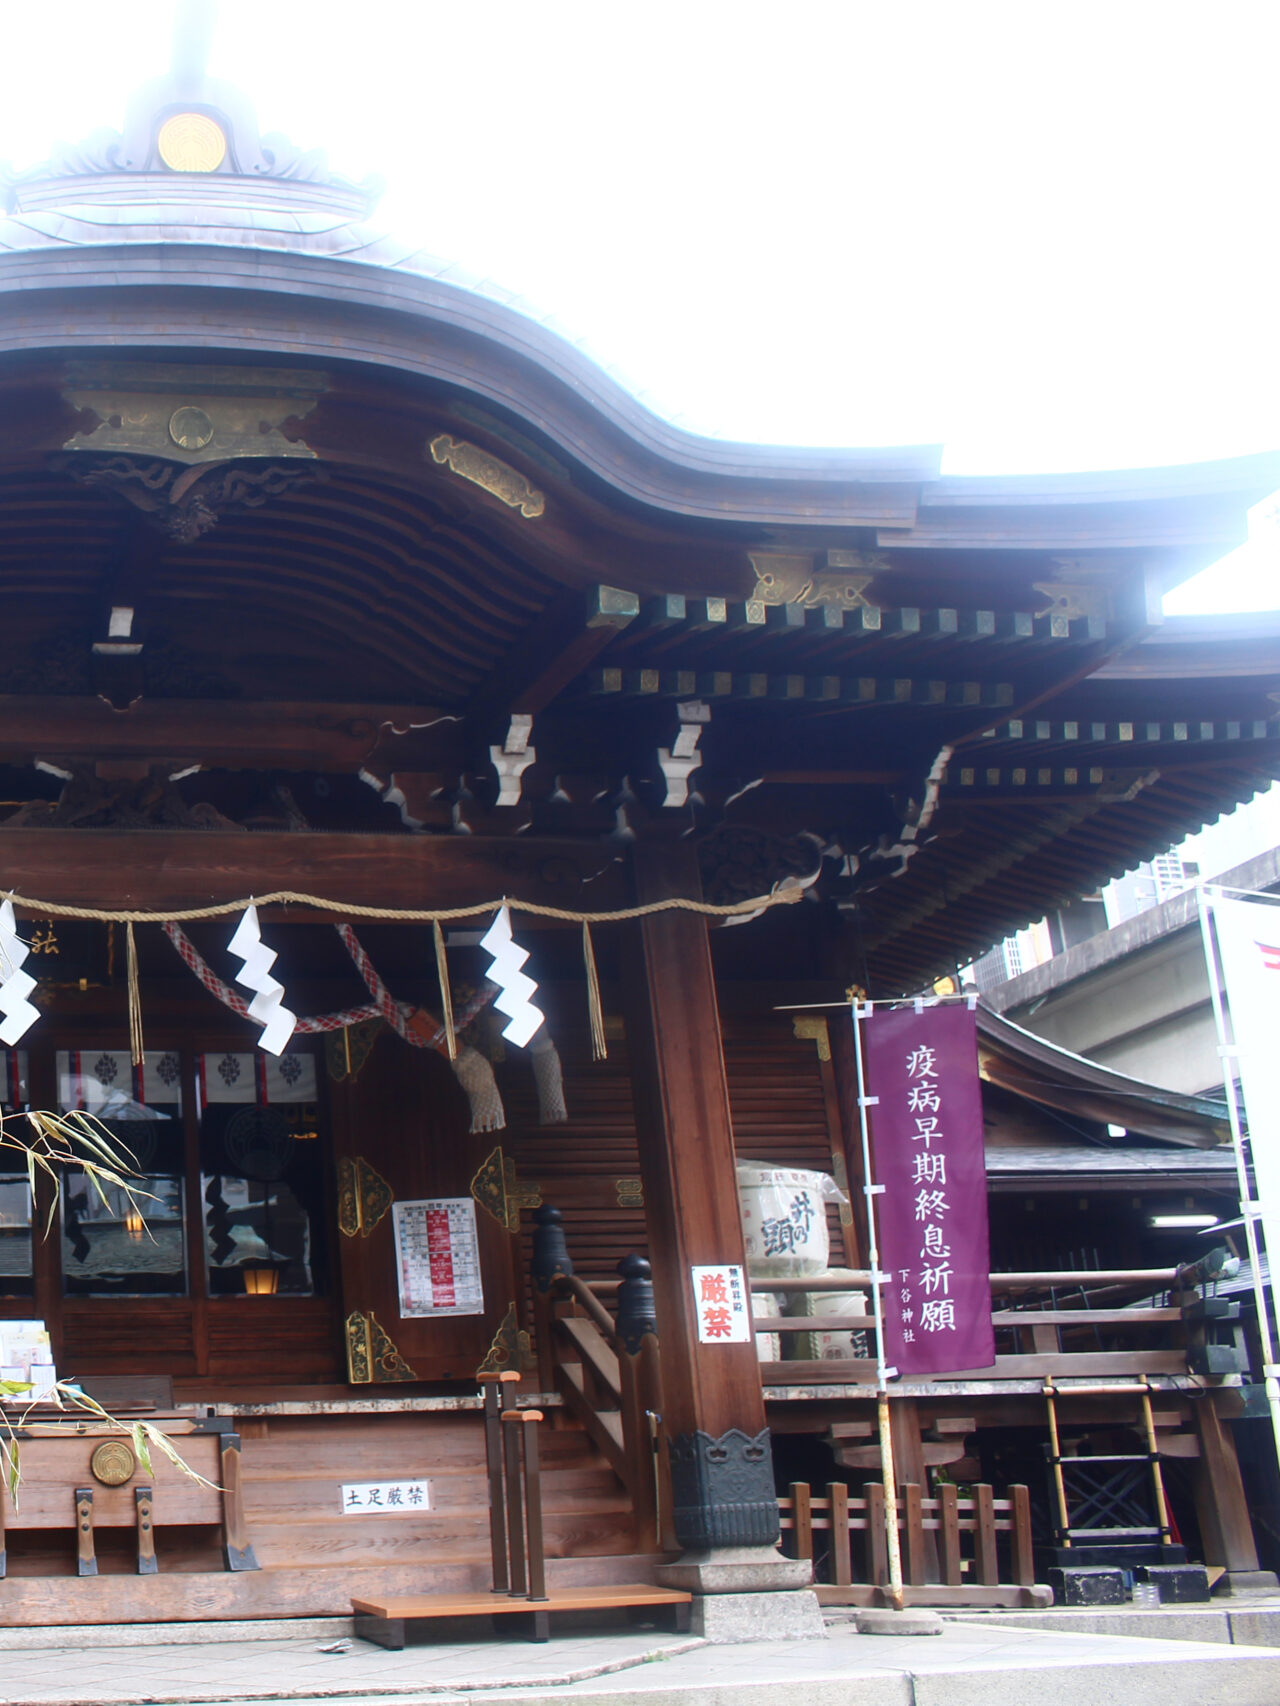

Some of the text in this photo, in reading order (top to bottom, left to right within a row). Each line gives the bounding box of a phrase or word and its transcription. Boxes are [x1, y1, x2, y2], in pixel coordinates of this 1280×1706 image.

[905, 1045, 956, 1333] 疫病早期終息祈願
[700, 1273, 733, 1338] 厳禁
[728, 1267, 743, 1312] 無断昇殿
[898, 1268, 916, 1344] 下谷神社
[345, 1485, 424, 1507] 土足厳禁
